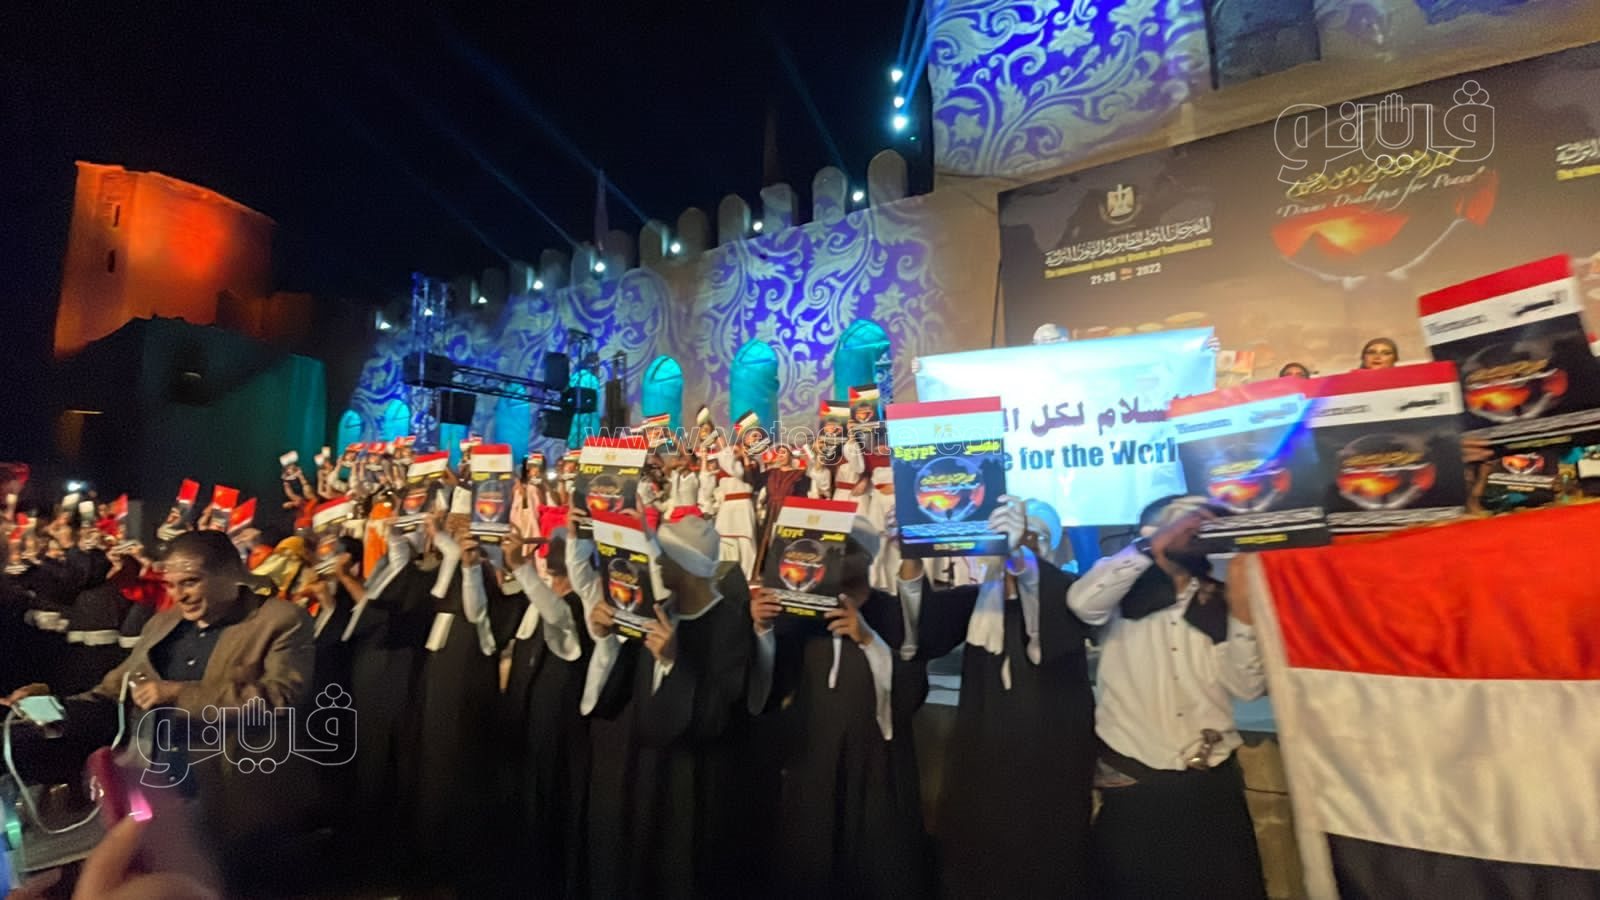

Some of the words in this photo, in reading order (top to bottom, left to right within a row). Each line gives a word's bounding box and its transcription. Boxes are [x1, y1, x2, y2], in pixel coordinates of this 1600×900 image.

[1136, 262, 1161, 277] 2022
[1031, 401, 1085, 437] لكل
[893, 445, 937, 462] Egypt
[1019, 446, 1055, 471] for
[1062, 442, 1104, 468] the
[1110, 437, 1177, 465] Worl
[777, 526, 805, 538] Egypt
